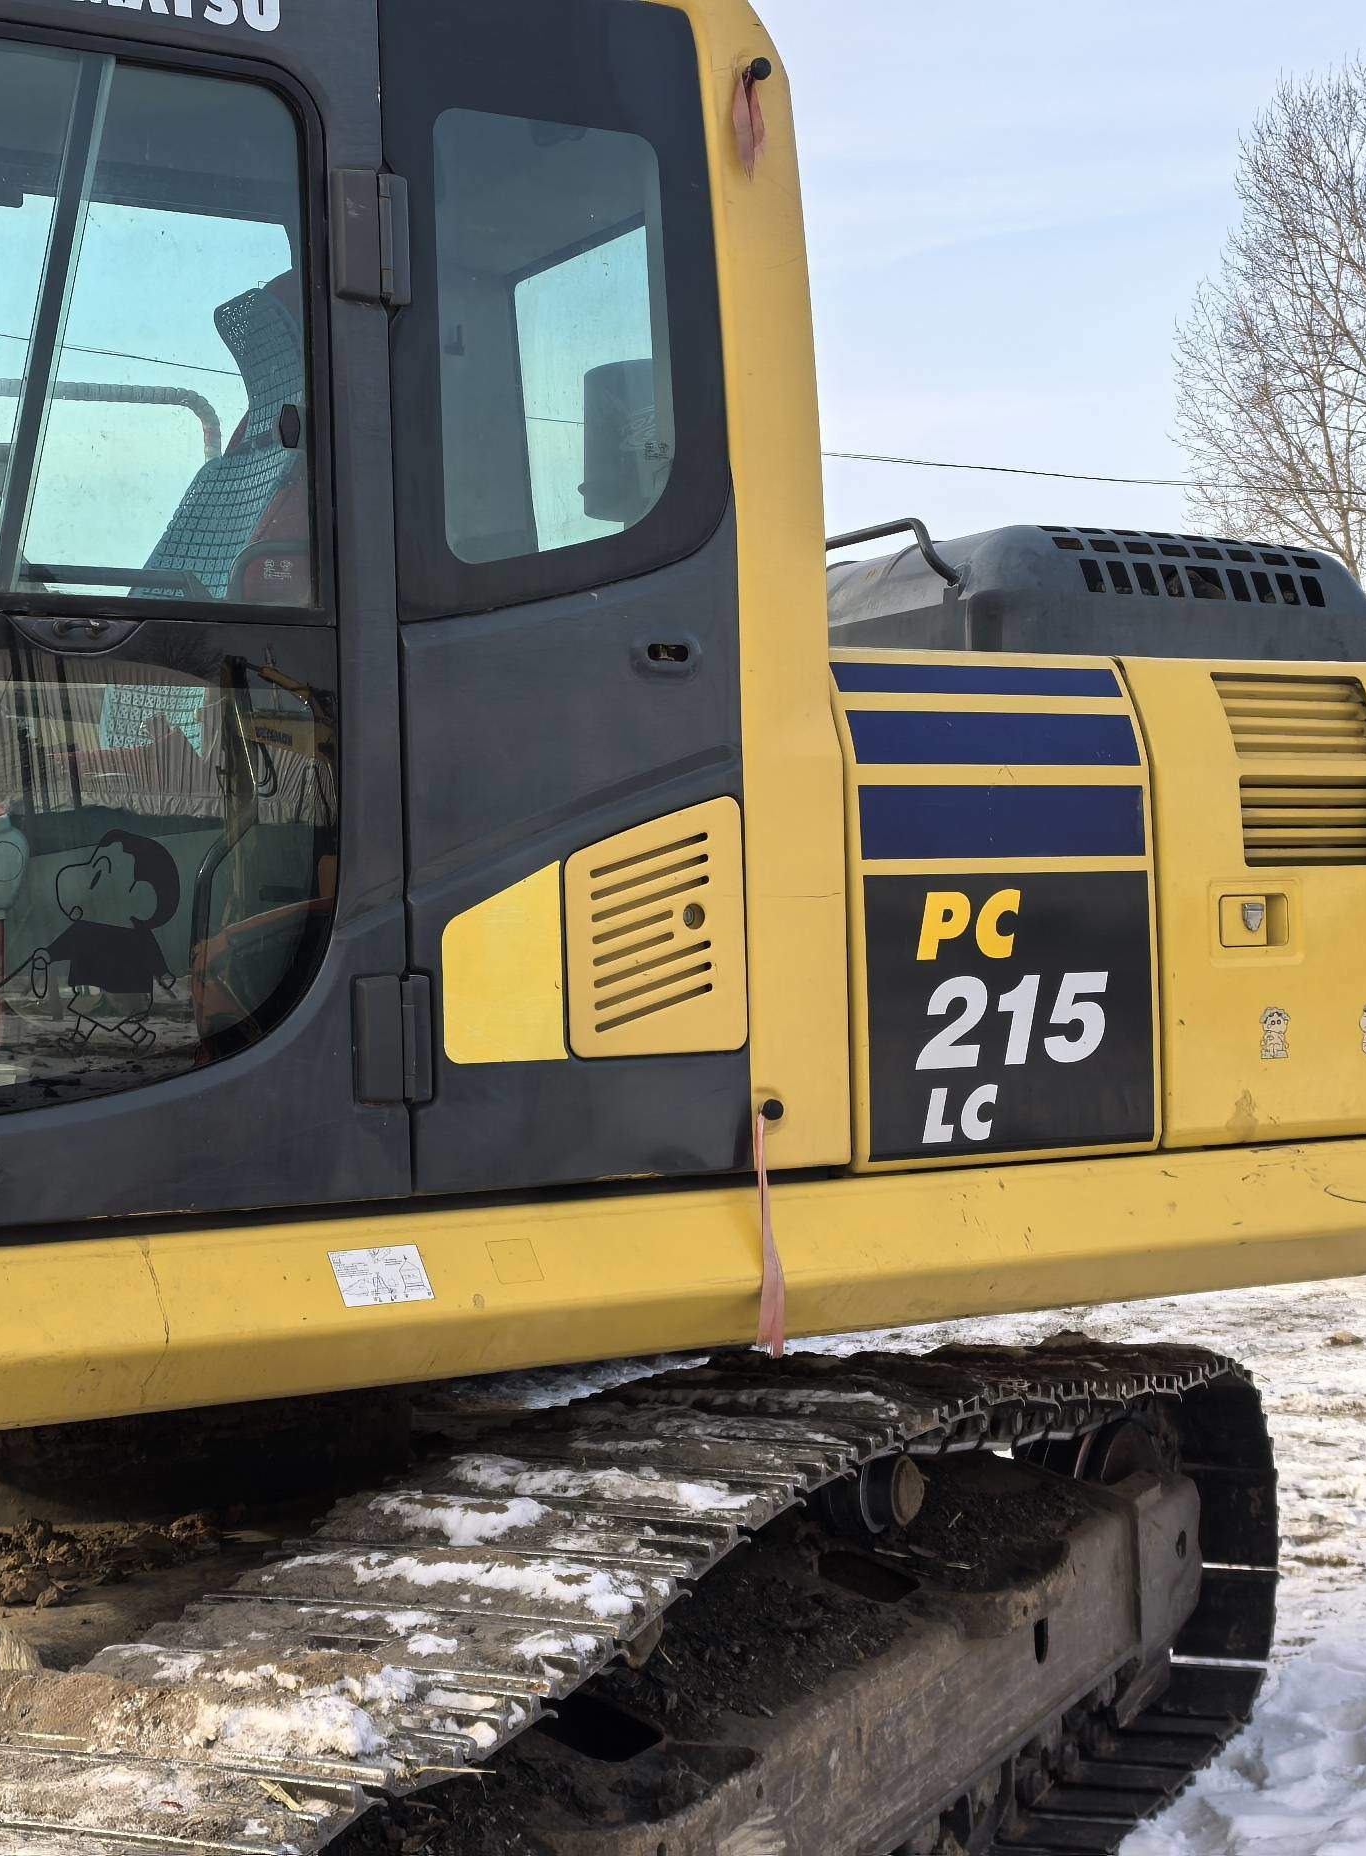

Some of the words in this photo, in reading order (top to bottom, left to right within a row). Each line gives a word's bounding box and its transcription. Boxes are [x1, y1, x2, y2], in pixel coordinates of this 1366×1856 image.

[916, 888, 1021, 960] PC
[915, 971, 1108, 1070] 215
[922, 1083, 998, 1143] LC
